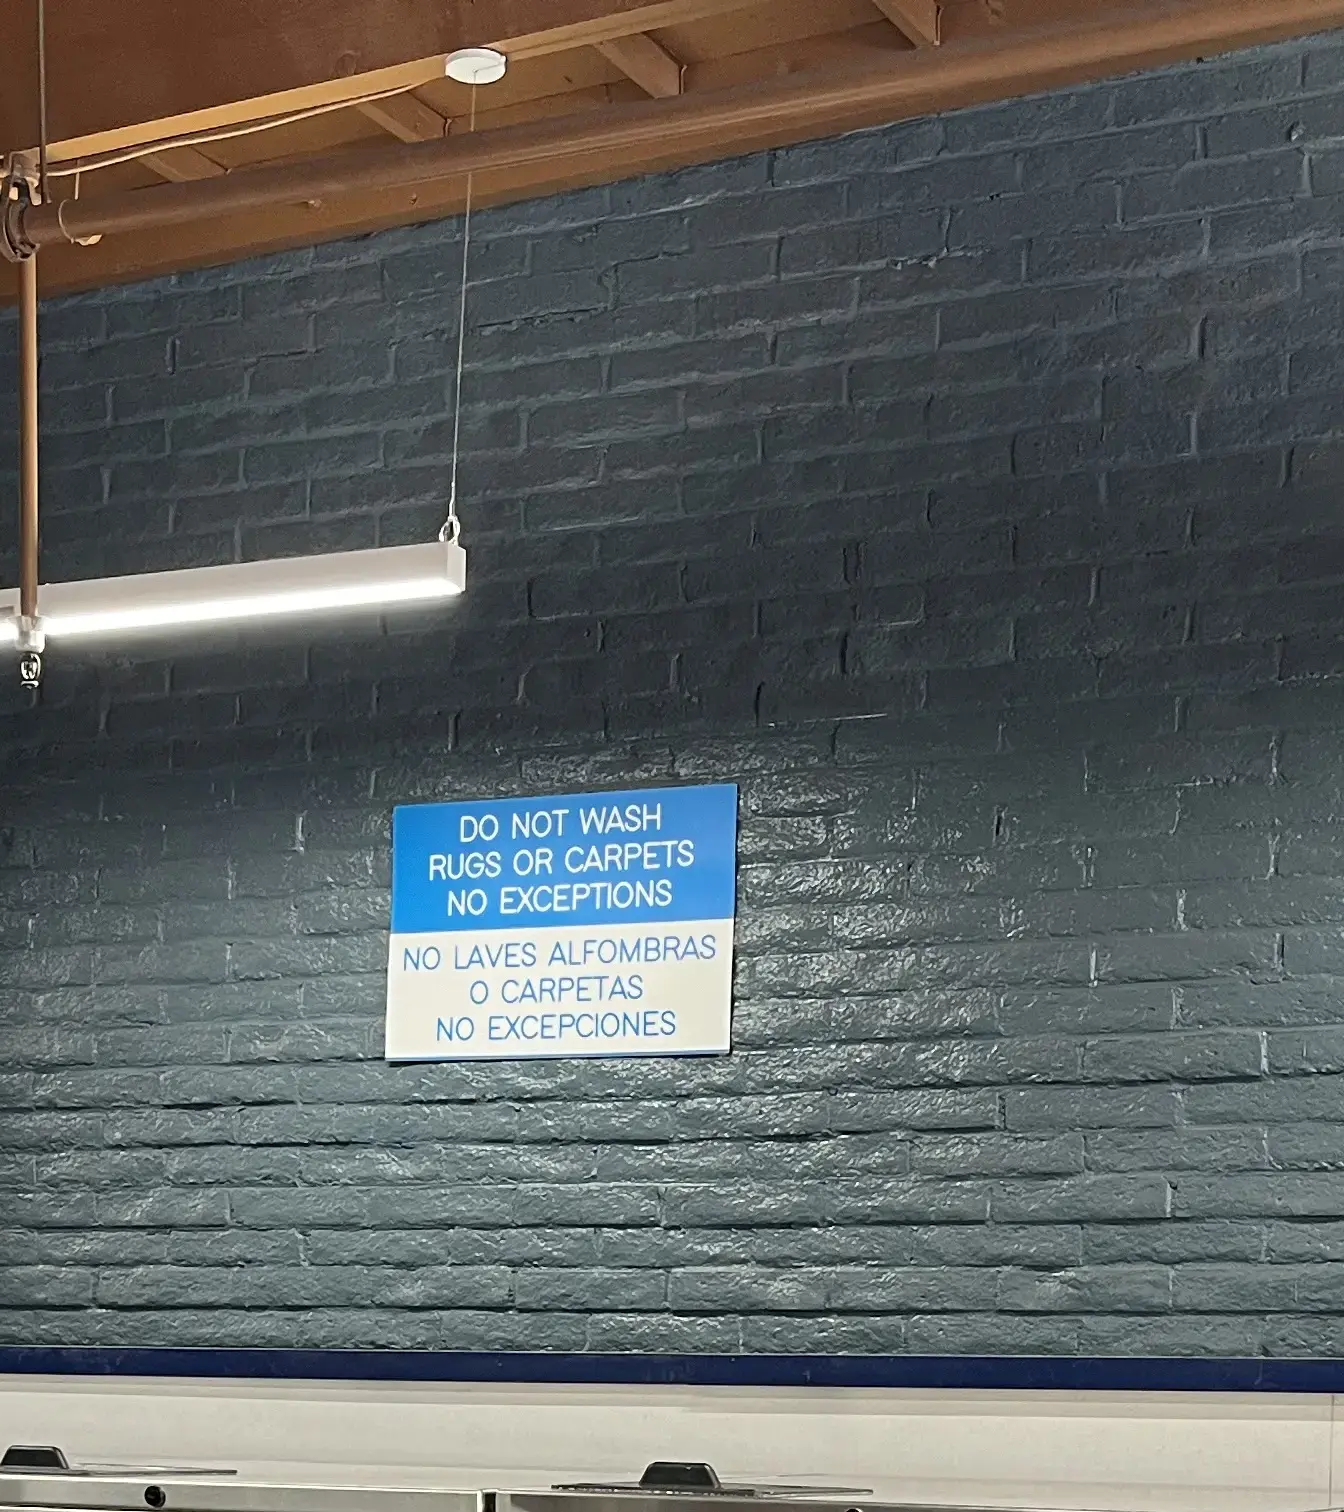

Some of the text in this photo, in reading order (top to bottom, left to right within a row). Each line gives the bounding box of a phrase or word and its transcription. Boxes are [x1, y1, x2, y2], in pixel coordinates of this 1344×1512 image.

[459, 803, 662, 843] DO NOT WASH
[428, 839, 695, 881] RUGS OR CARPETS
[447, 878, 673, 917] NO EXCEPTIONS
[403, 934, 717, 971] NO LAVES ALFOMBRAS
[469, 974, 644, 1005] O CARPETAS
[436, 1010, 676, 1042] NO EXCEPCIONES
